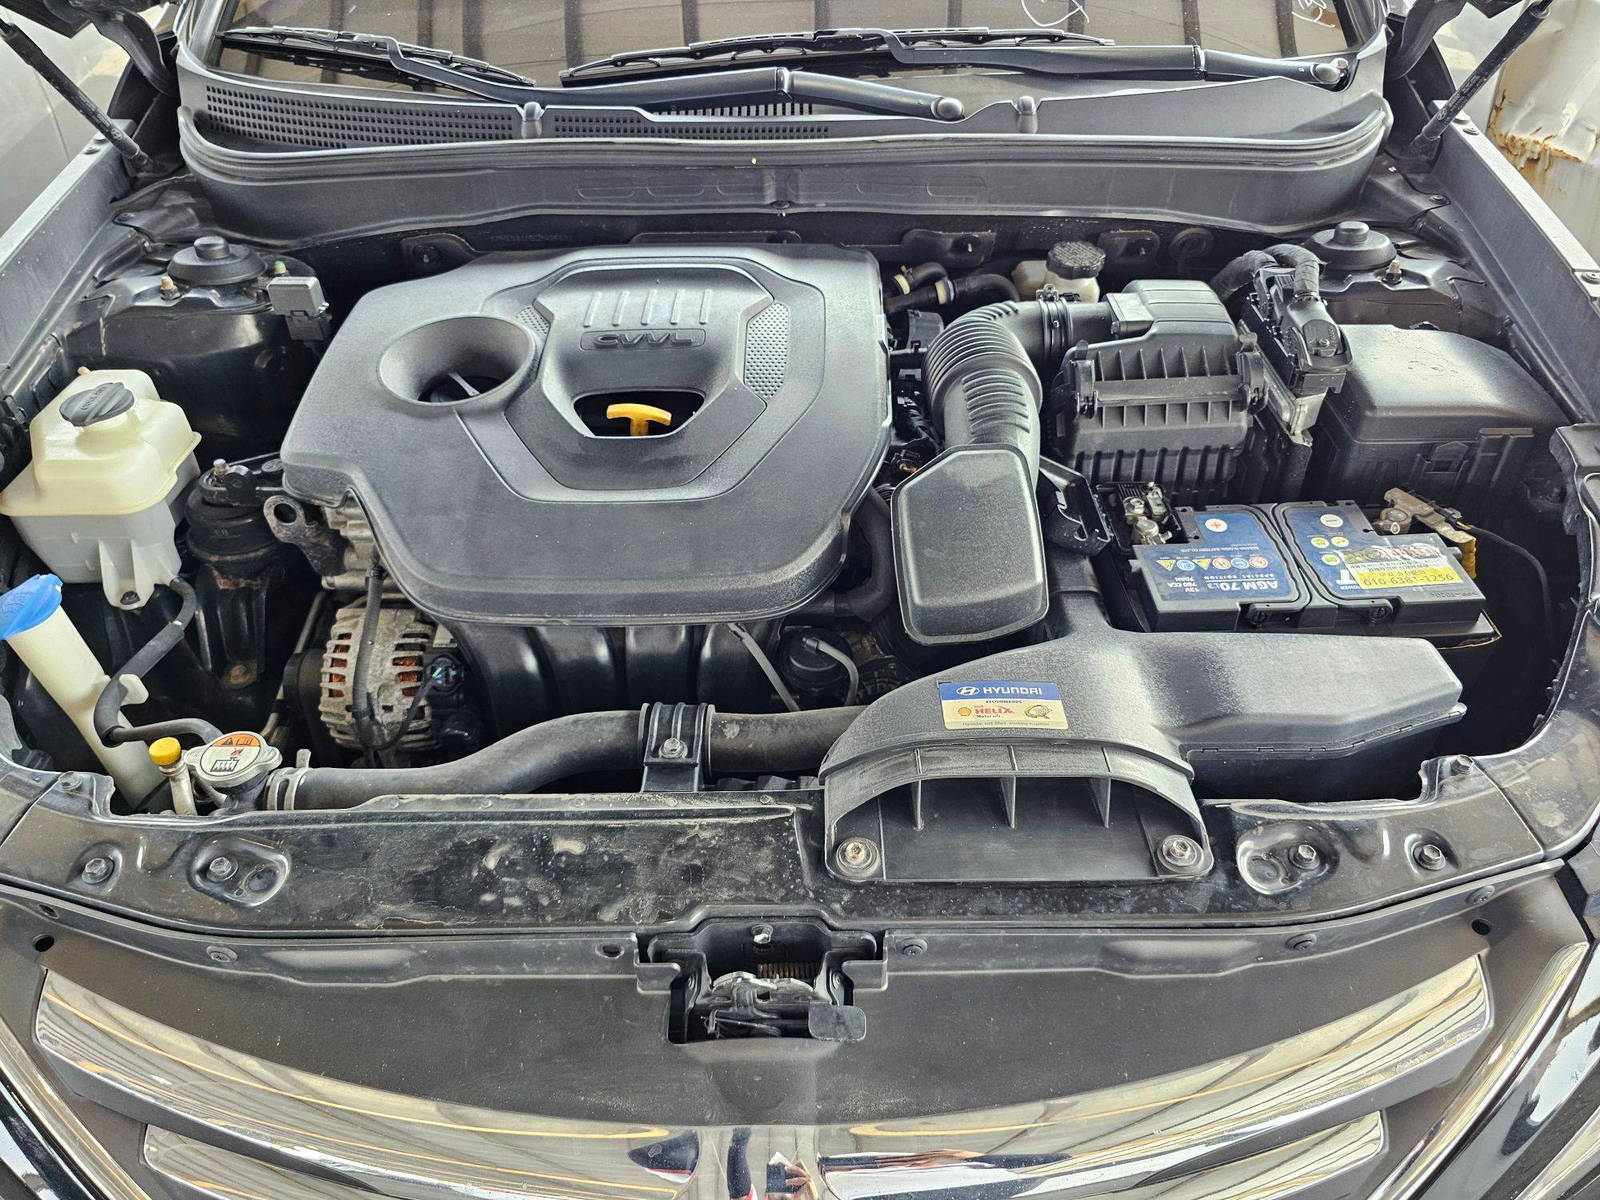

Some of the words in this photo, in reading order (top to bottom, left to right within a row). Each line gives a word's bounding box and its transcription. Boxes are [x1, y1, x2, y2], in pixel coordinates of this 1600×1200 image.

[594, 332, 693, 349] CVVL
[1242, 580, 1278, 590] AGM
[983, 686, 1043, 695] HYUNDAI
[975, 706, 1014, 714] HELIX
